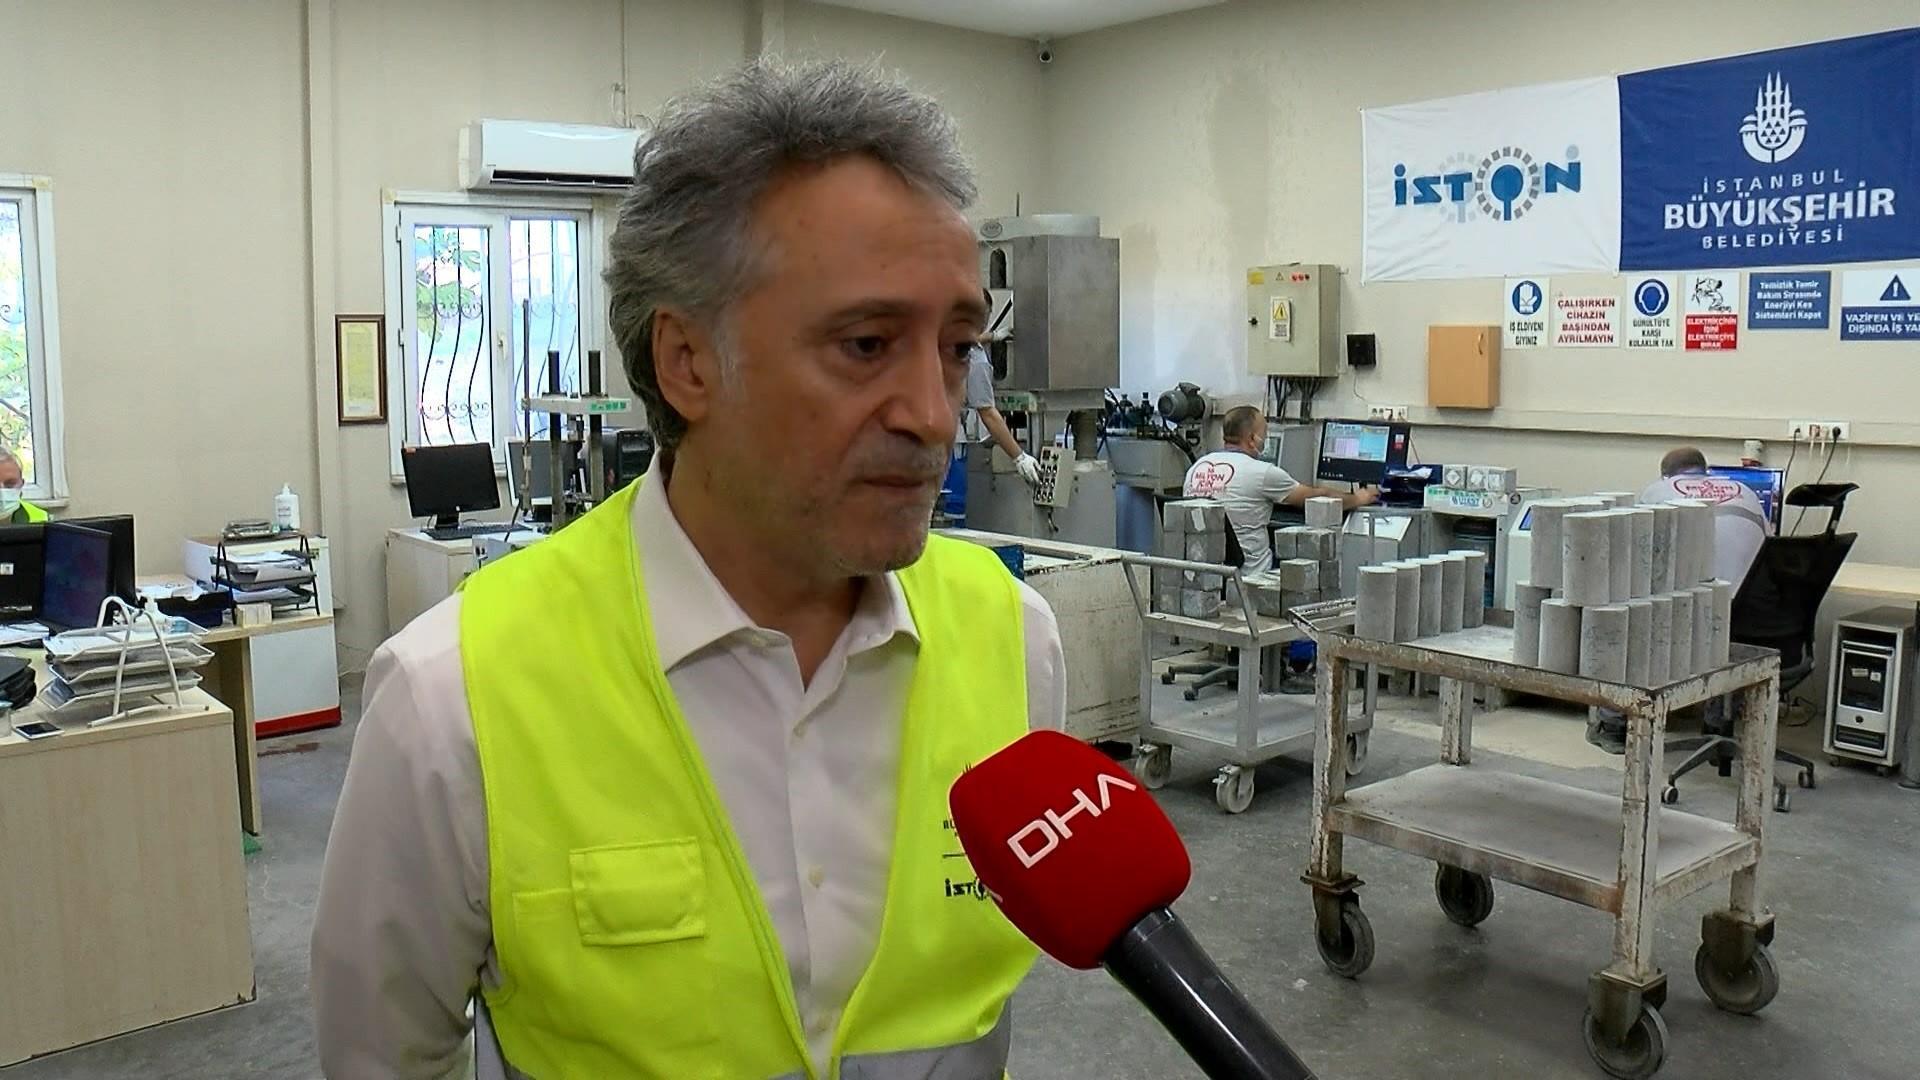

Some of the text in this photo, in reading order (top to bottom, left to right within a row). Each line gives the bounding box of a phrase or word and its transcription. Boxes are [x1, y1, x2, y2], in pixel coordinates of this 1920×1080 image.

[1702, 168, 1845, 194] İSTANBUL
[1664, 181, 1896, 232] BÜYÜKŞEHİR
[1702, 224, 1844, 249] BELEDİYESİ
[1760, 281, 1794, 289] Temizlik
[1557, 298, 1615, 309] ÇALIŞIRKEN
[1562, 322, 1610, 333] BAŞINDAN
[1848, 323, 1890, 335] DIŞINDA
[1904, 324, 1920, 333] YA
[1558, 334, 1614, 343] AYRILMAYIN
[1642, 329, 1661, 338] KARŞI
[1661, 339, 1674, 347] TAK
[1007, 773, 1137, 869] DHA
